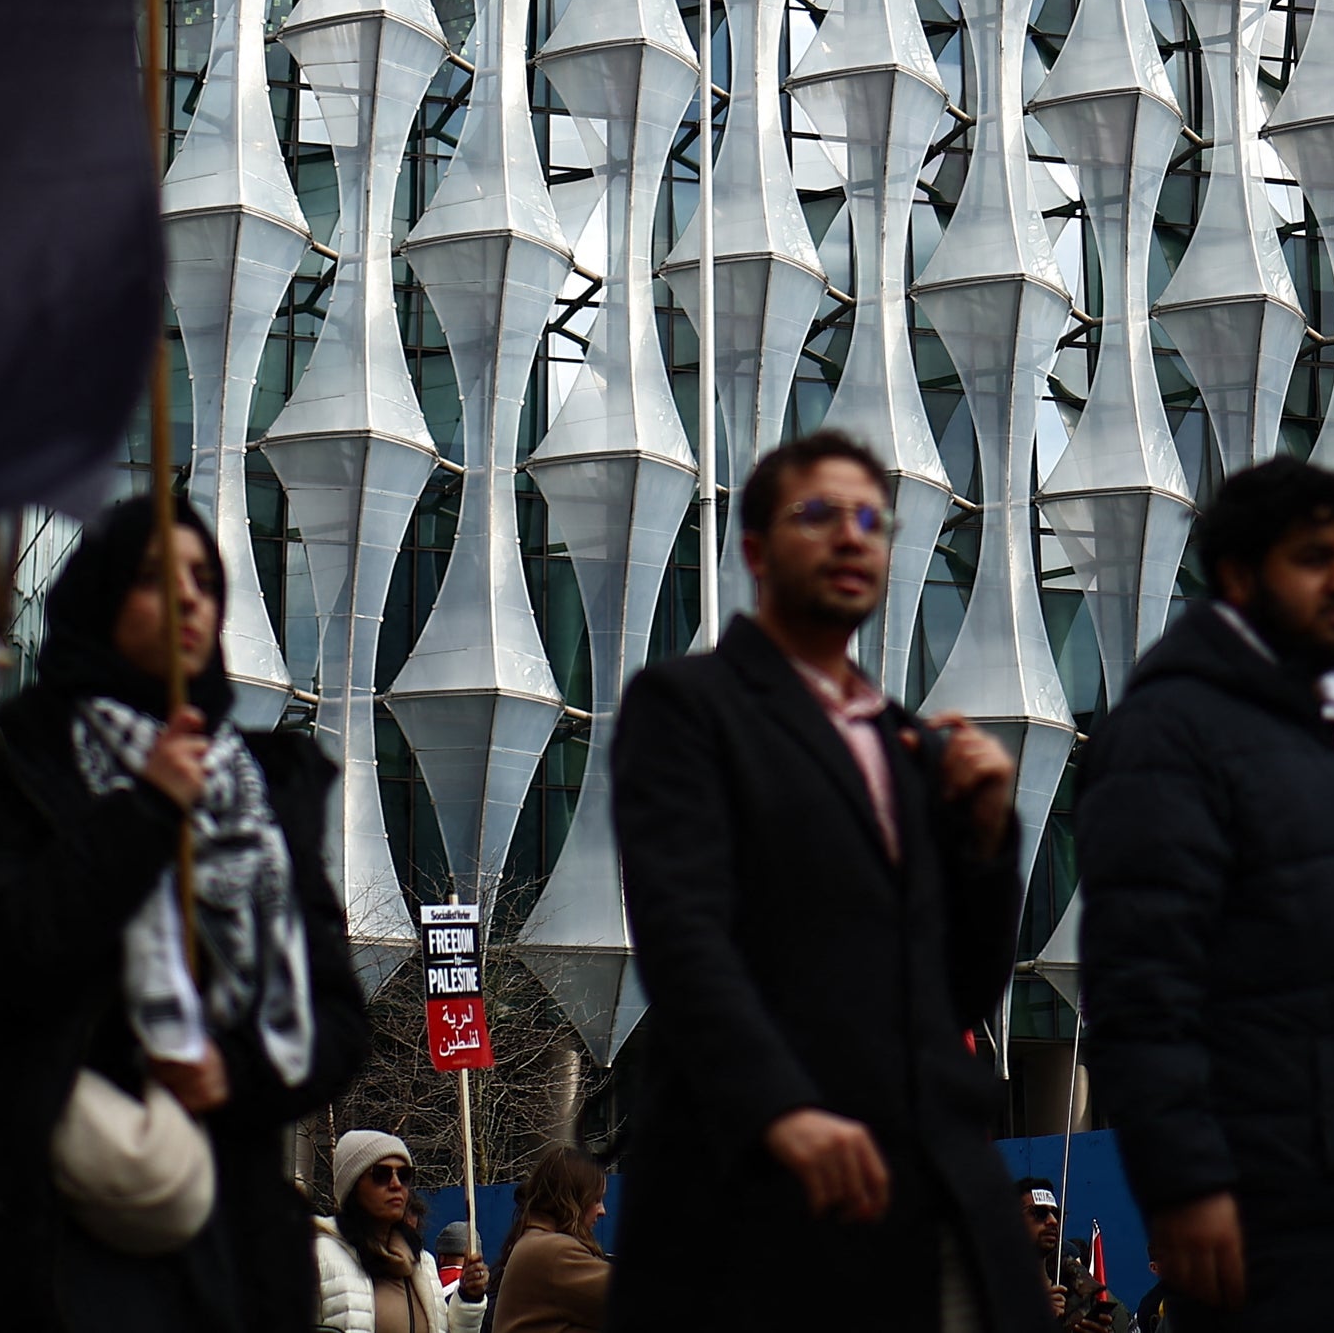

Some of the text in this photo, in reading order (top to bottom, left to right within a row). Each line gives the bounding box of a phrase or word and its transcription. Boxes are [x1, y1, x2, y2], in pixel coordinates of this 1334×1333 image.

[428, 928, 474, 954] FREEDOM
[454, 953, 462, 966] for
[428, 967, 479, 994] PALESTINE
